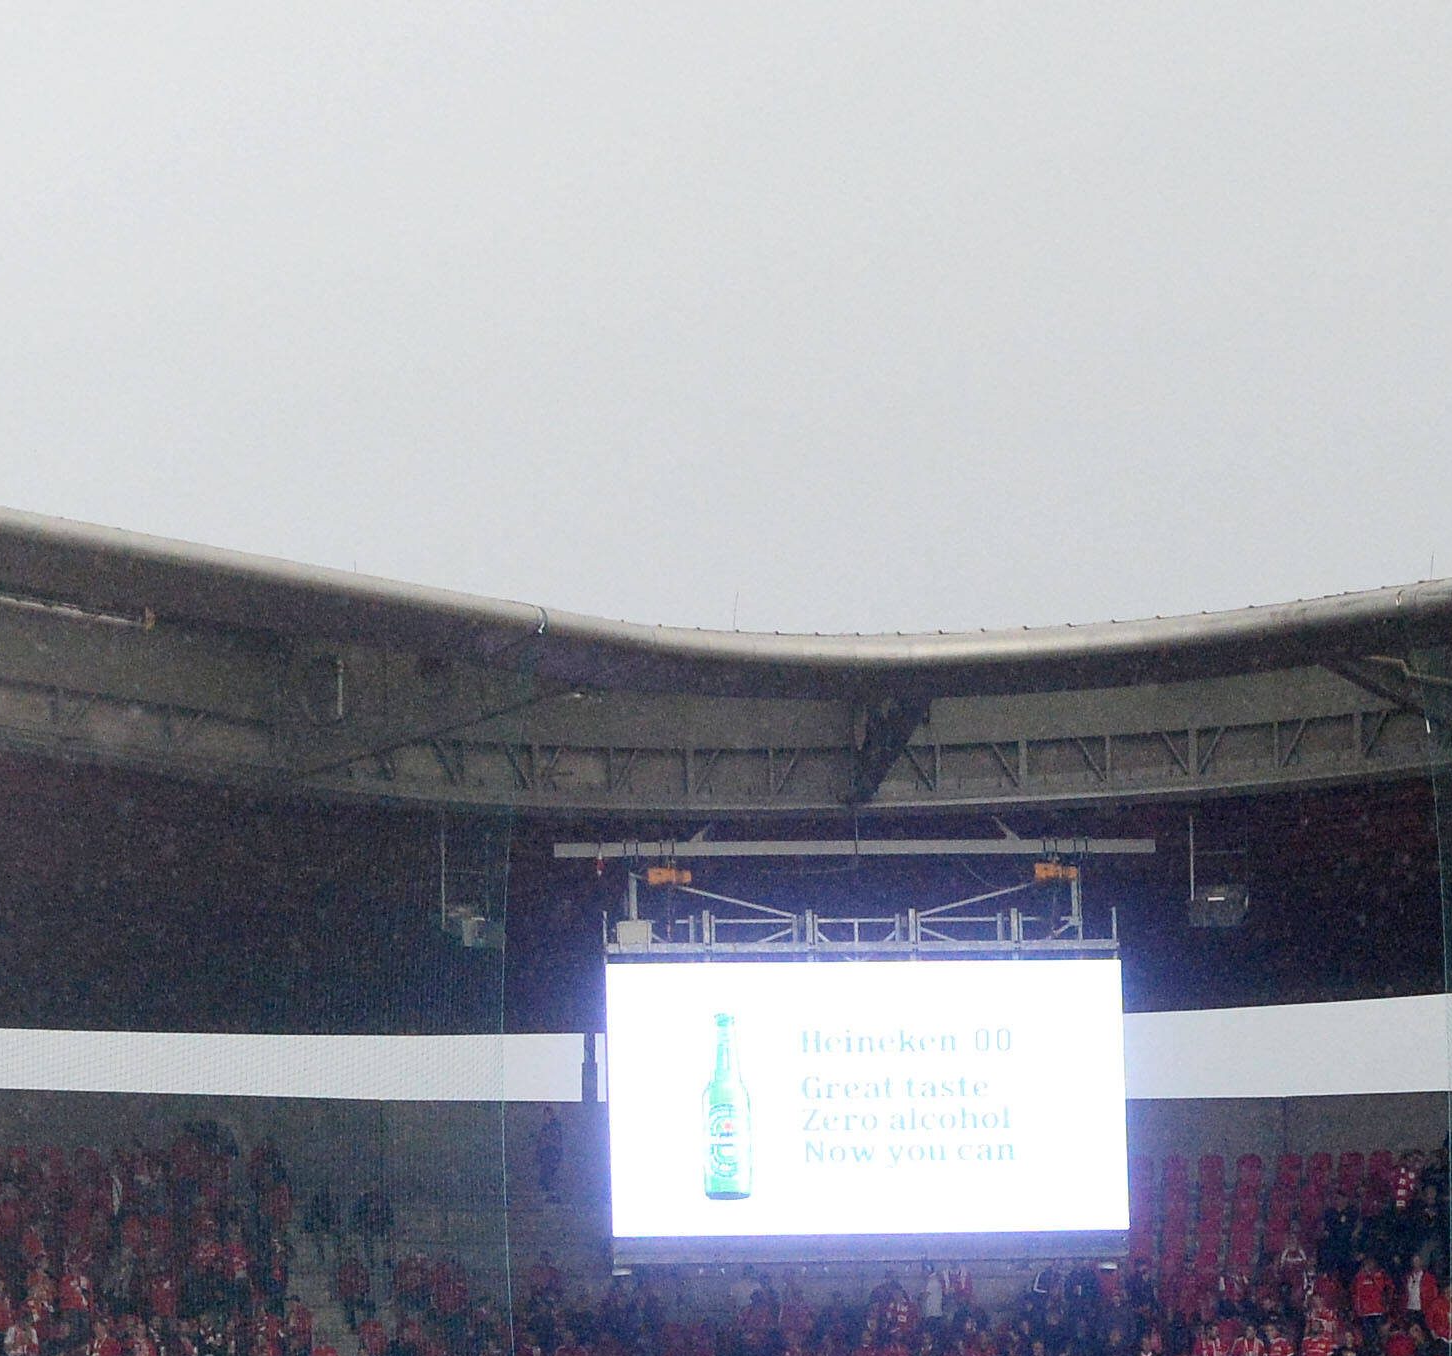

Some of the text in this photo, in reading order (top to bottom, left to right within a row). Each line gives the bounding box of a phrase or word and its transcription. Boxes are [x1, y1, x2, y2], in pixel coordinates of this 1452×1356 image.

[801, 1029, 957, 1053] Heineken
[801, 1075, 988, 1099] Great taste
[802, 1105, 1011, 1131] Zero alcohol
[804, 1138, 1015, 1168] Now you can
